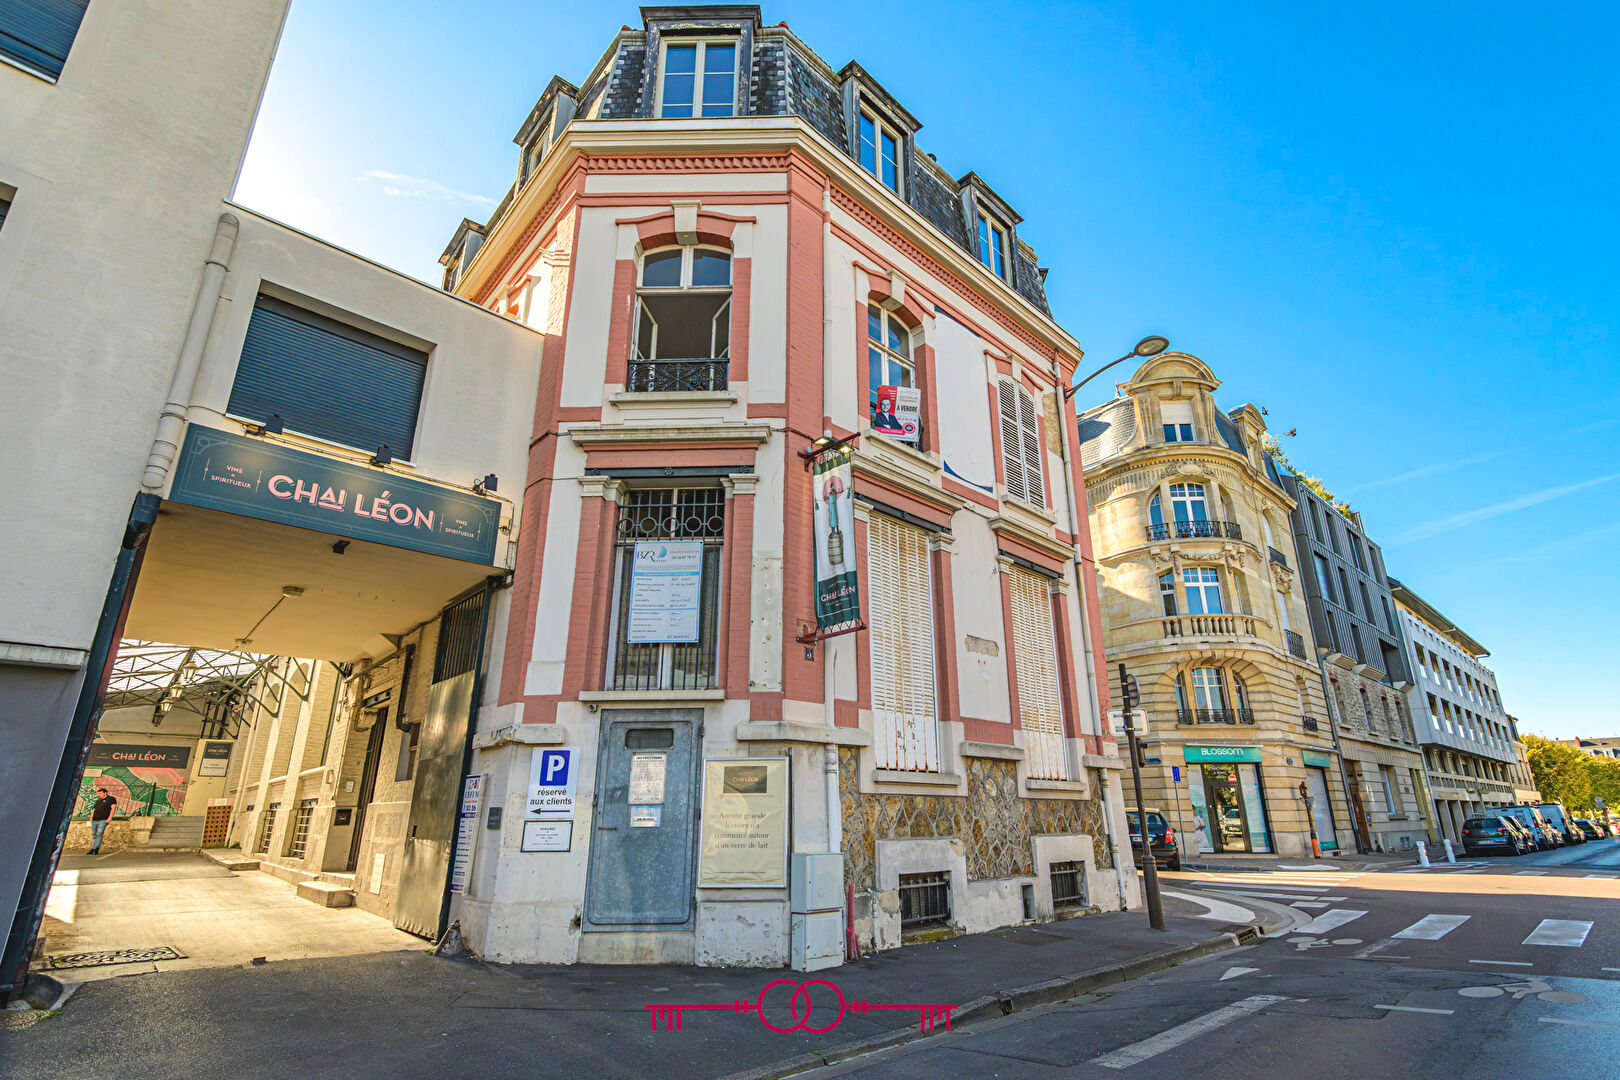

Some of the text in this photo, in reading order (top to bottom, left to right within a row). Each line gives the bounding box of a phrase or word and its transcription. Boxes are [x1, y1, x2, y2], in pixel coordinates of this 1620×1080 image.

[226, 465, 244, 474] VINS
[210, 475, 252, 489] SPIRITUEUX
[268, 474, 435, 532] CHAI LÉON
[445, 527, 474, 539] SPIRITUEUX
[138, 750, 166, 761] LÉON
[546, 755, 565, 781] P
